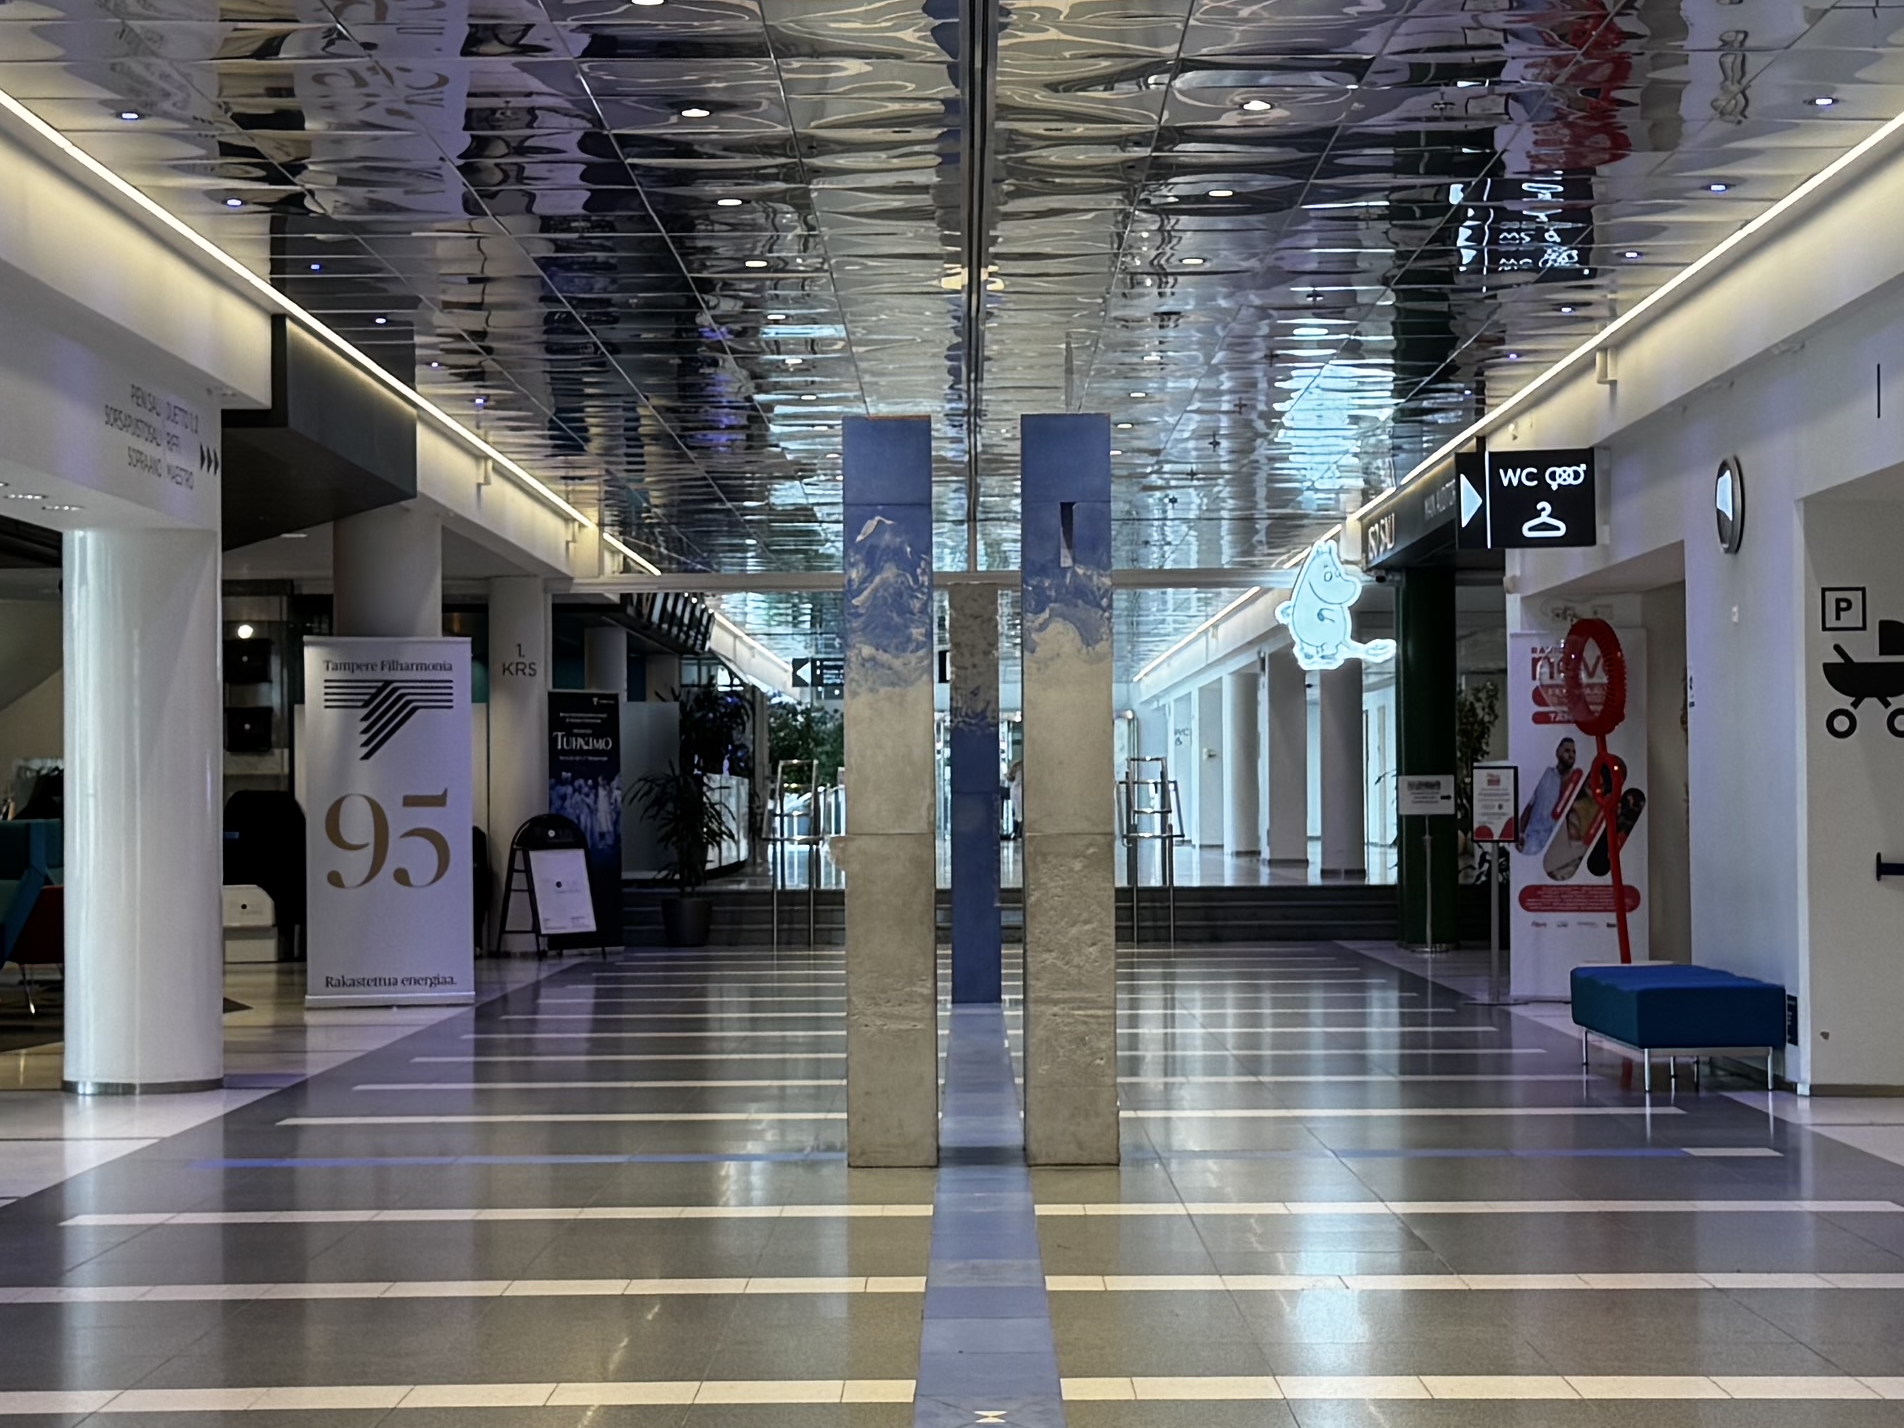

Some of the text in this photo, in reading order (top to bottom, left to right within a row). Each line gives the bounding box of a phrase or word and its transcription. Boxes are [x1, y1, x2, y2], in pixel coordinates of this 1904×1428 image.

[1499, 467, 1538, 487] WC
[1834, 597, 1853, 620] P
[516, 643, 525, 658] 1.
[324, 659, 453, 673] Tampere Filharmonia
[502, 662, 537, 677] KRS
[325, 787, 451, 889] 95
[325, 975, 398, 989] Rakastettua
